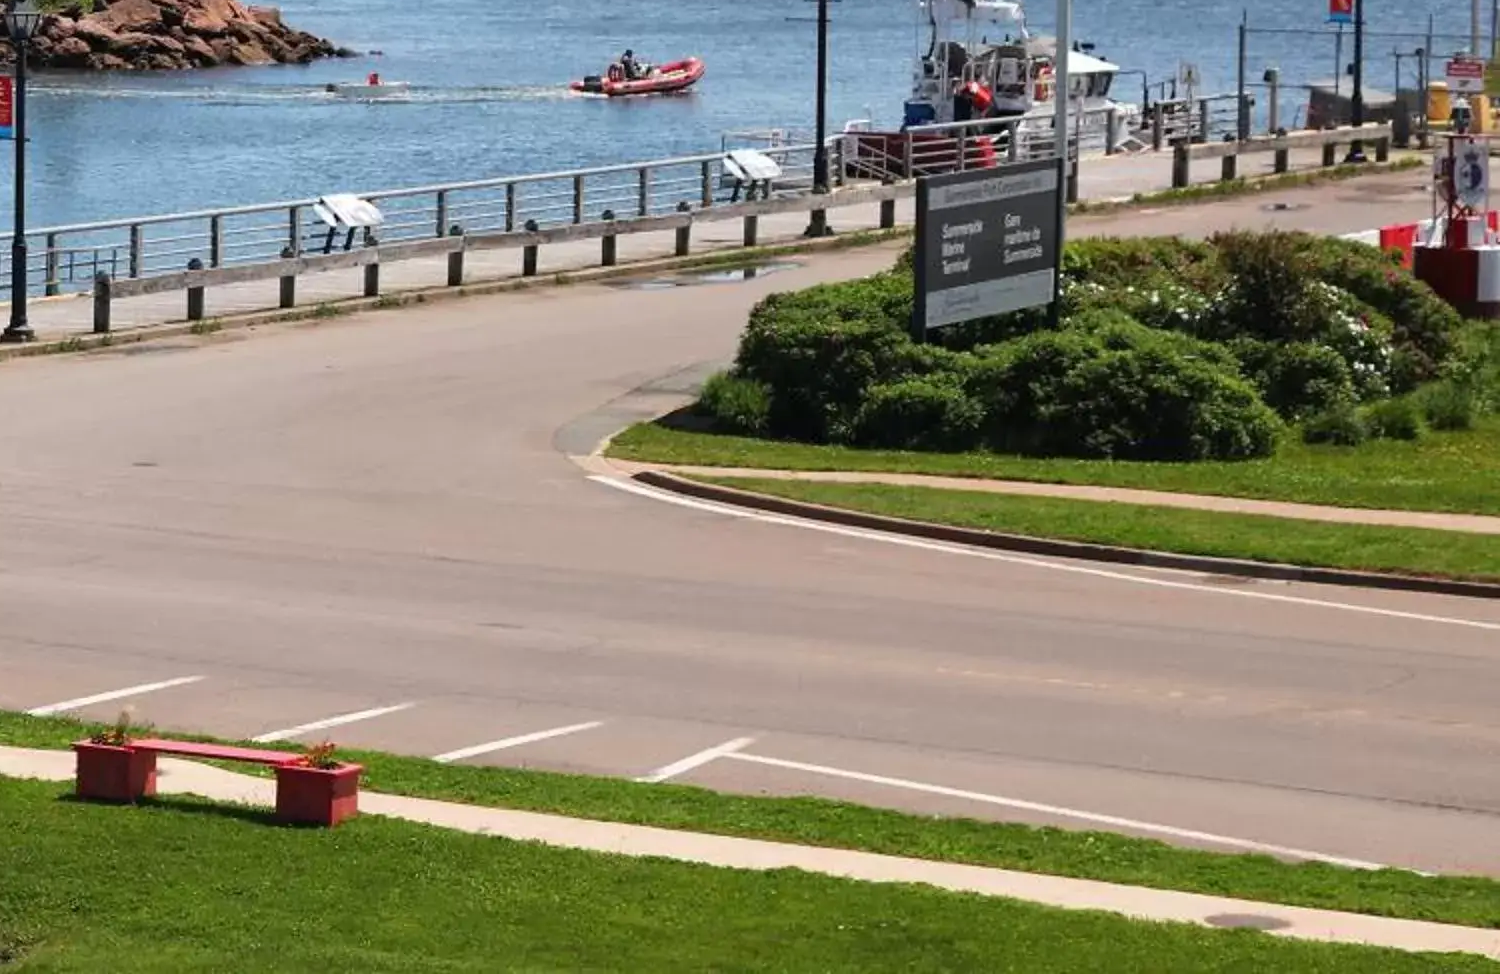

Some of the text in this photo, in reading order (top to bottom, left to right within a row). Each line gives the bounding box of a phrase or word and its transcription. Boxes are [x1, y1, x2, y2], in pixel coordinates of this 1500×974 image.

[942, 220, 983, 239] Summerside
[942, 242, 965, 257] Marine
[1003, 245, 1043, 264] Summerside
[942, 258, 971, 274] Terminal
